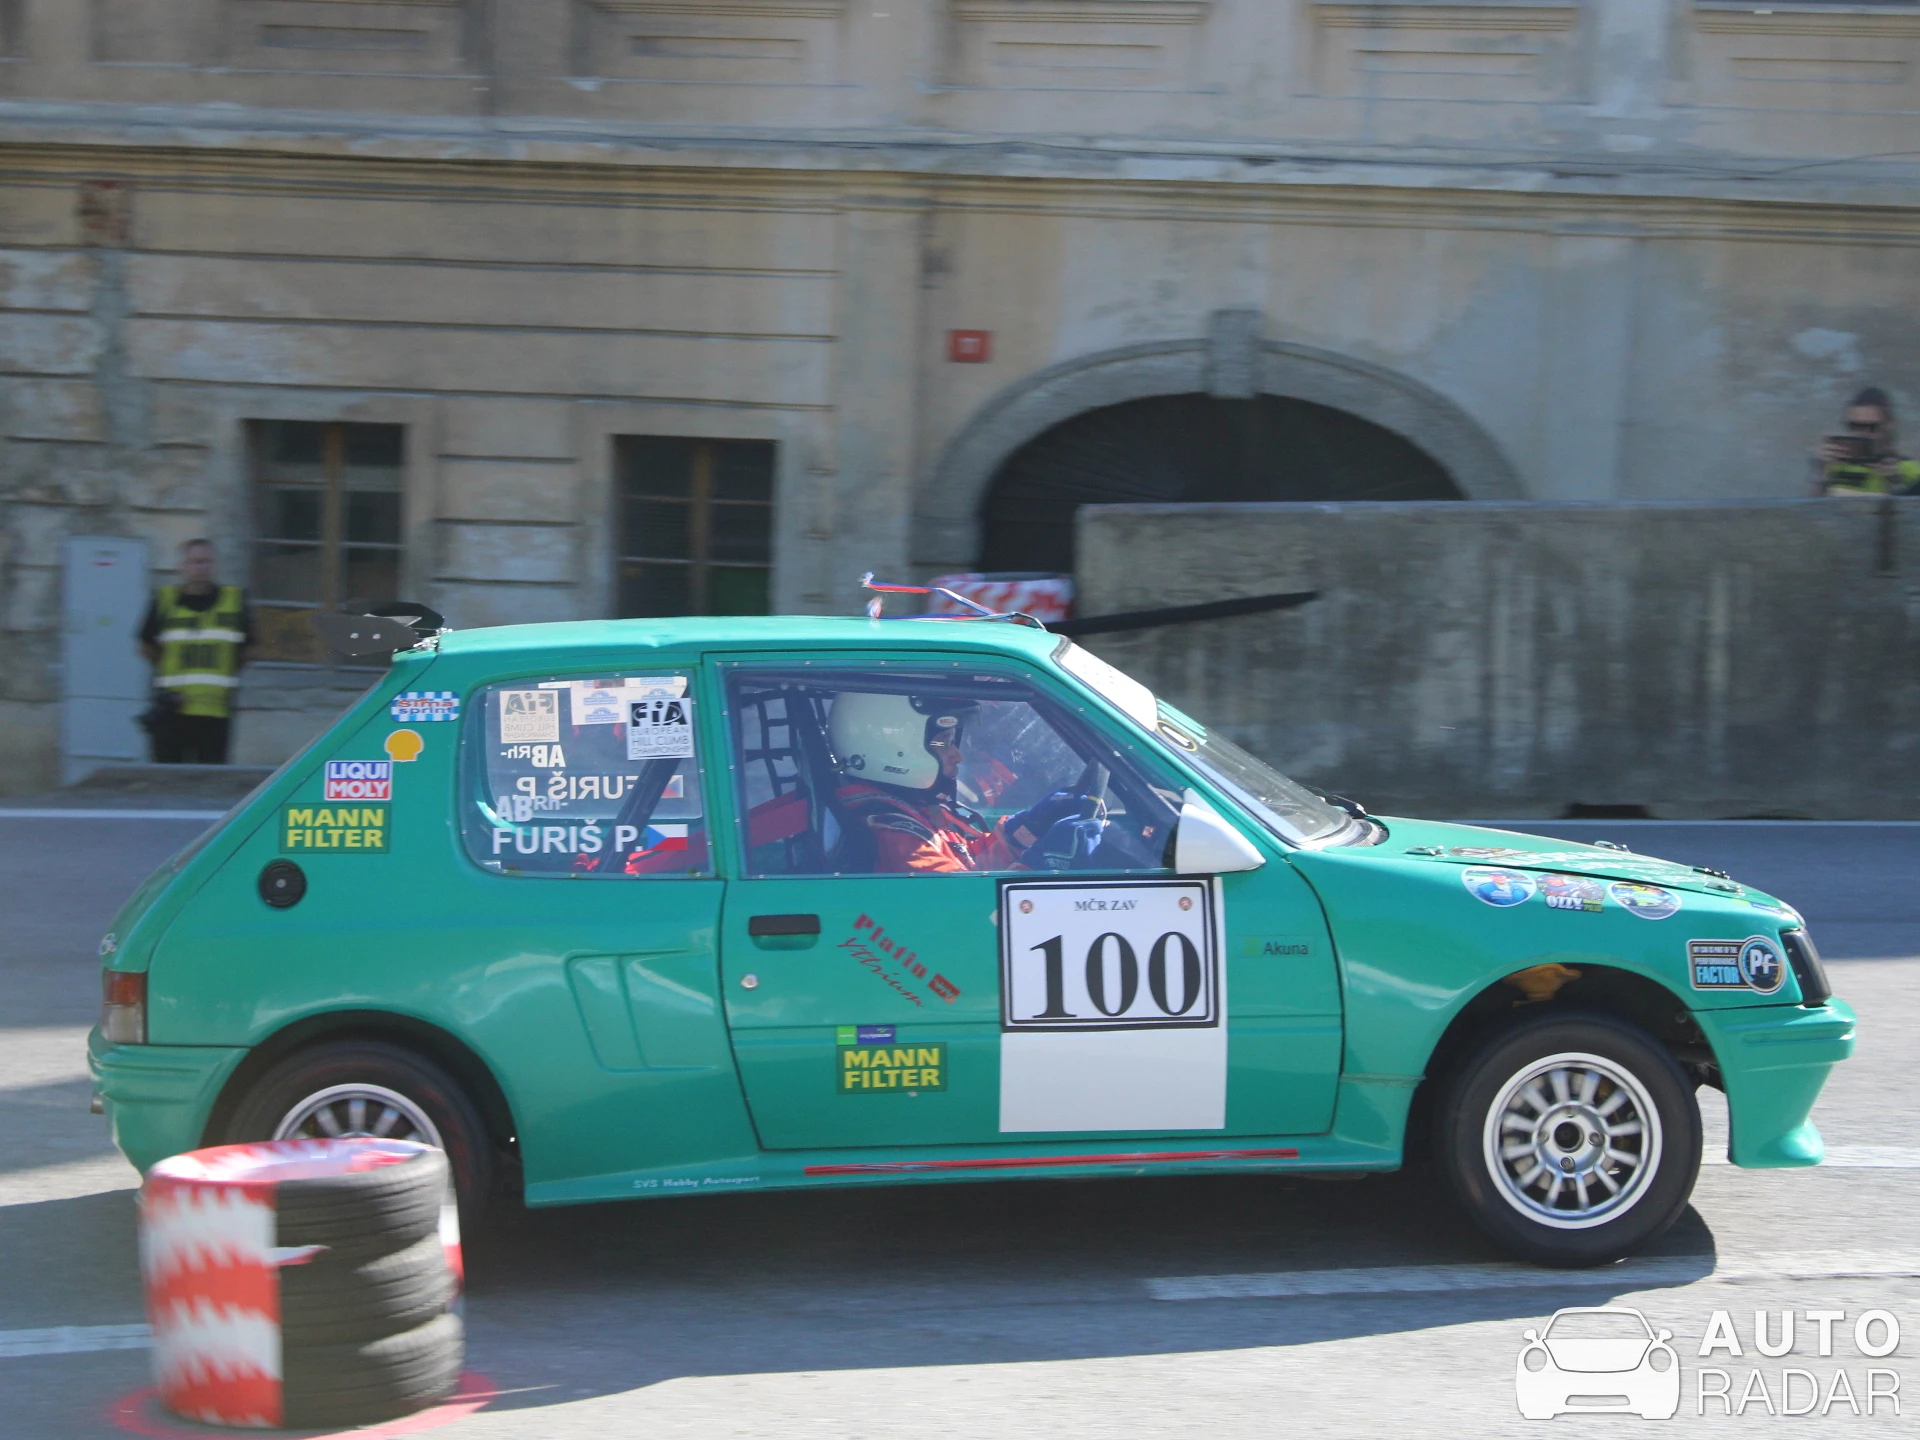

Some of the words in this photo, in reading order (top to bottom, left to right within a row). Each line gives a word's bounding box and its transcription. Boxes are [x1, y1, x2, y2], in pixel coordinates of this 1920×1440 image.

[631, 727, 689, 737] EUROPEAN
[655, 735, 690, 745] CLIMB
[329, 763, 387, 780] LIQUI
[329, 781, 388, 798] MOLY
[287, 808, 385, 827] MANN
[286, 829, 384, 848] FILTER
[493, 819, 602, 854] FURIŠ
[1074, 898, 1109, 912] MČR
[1111, 899, 1138, 911] ZAV
[853, 913, 928, 980] Platin
[1263, 941, 1309, 955] Akuna
[1030, 932, 1201, 1018] 100
[844, 1048, 940, 1069] MANN
[844, 1069, 941, 1089] FILTER
